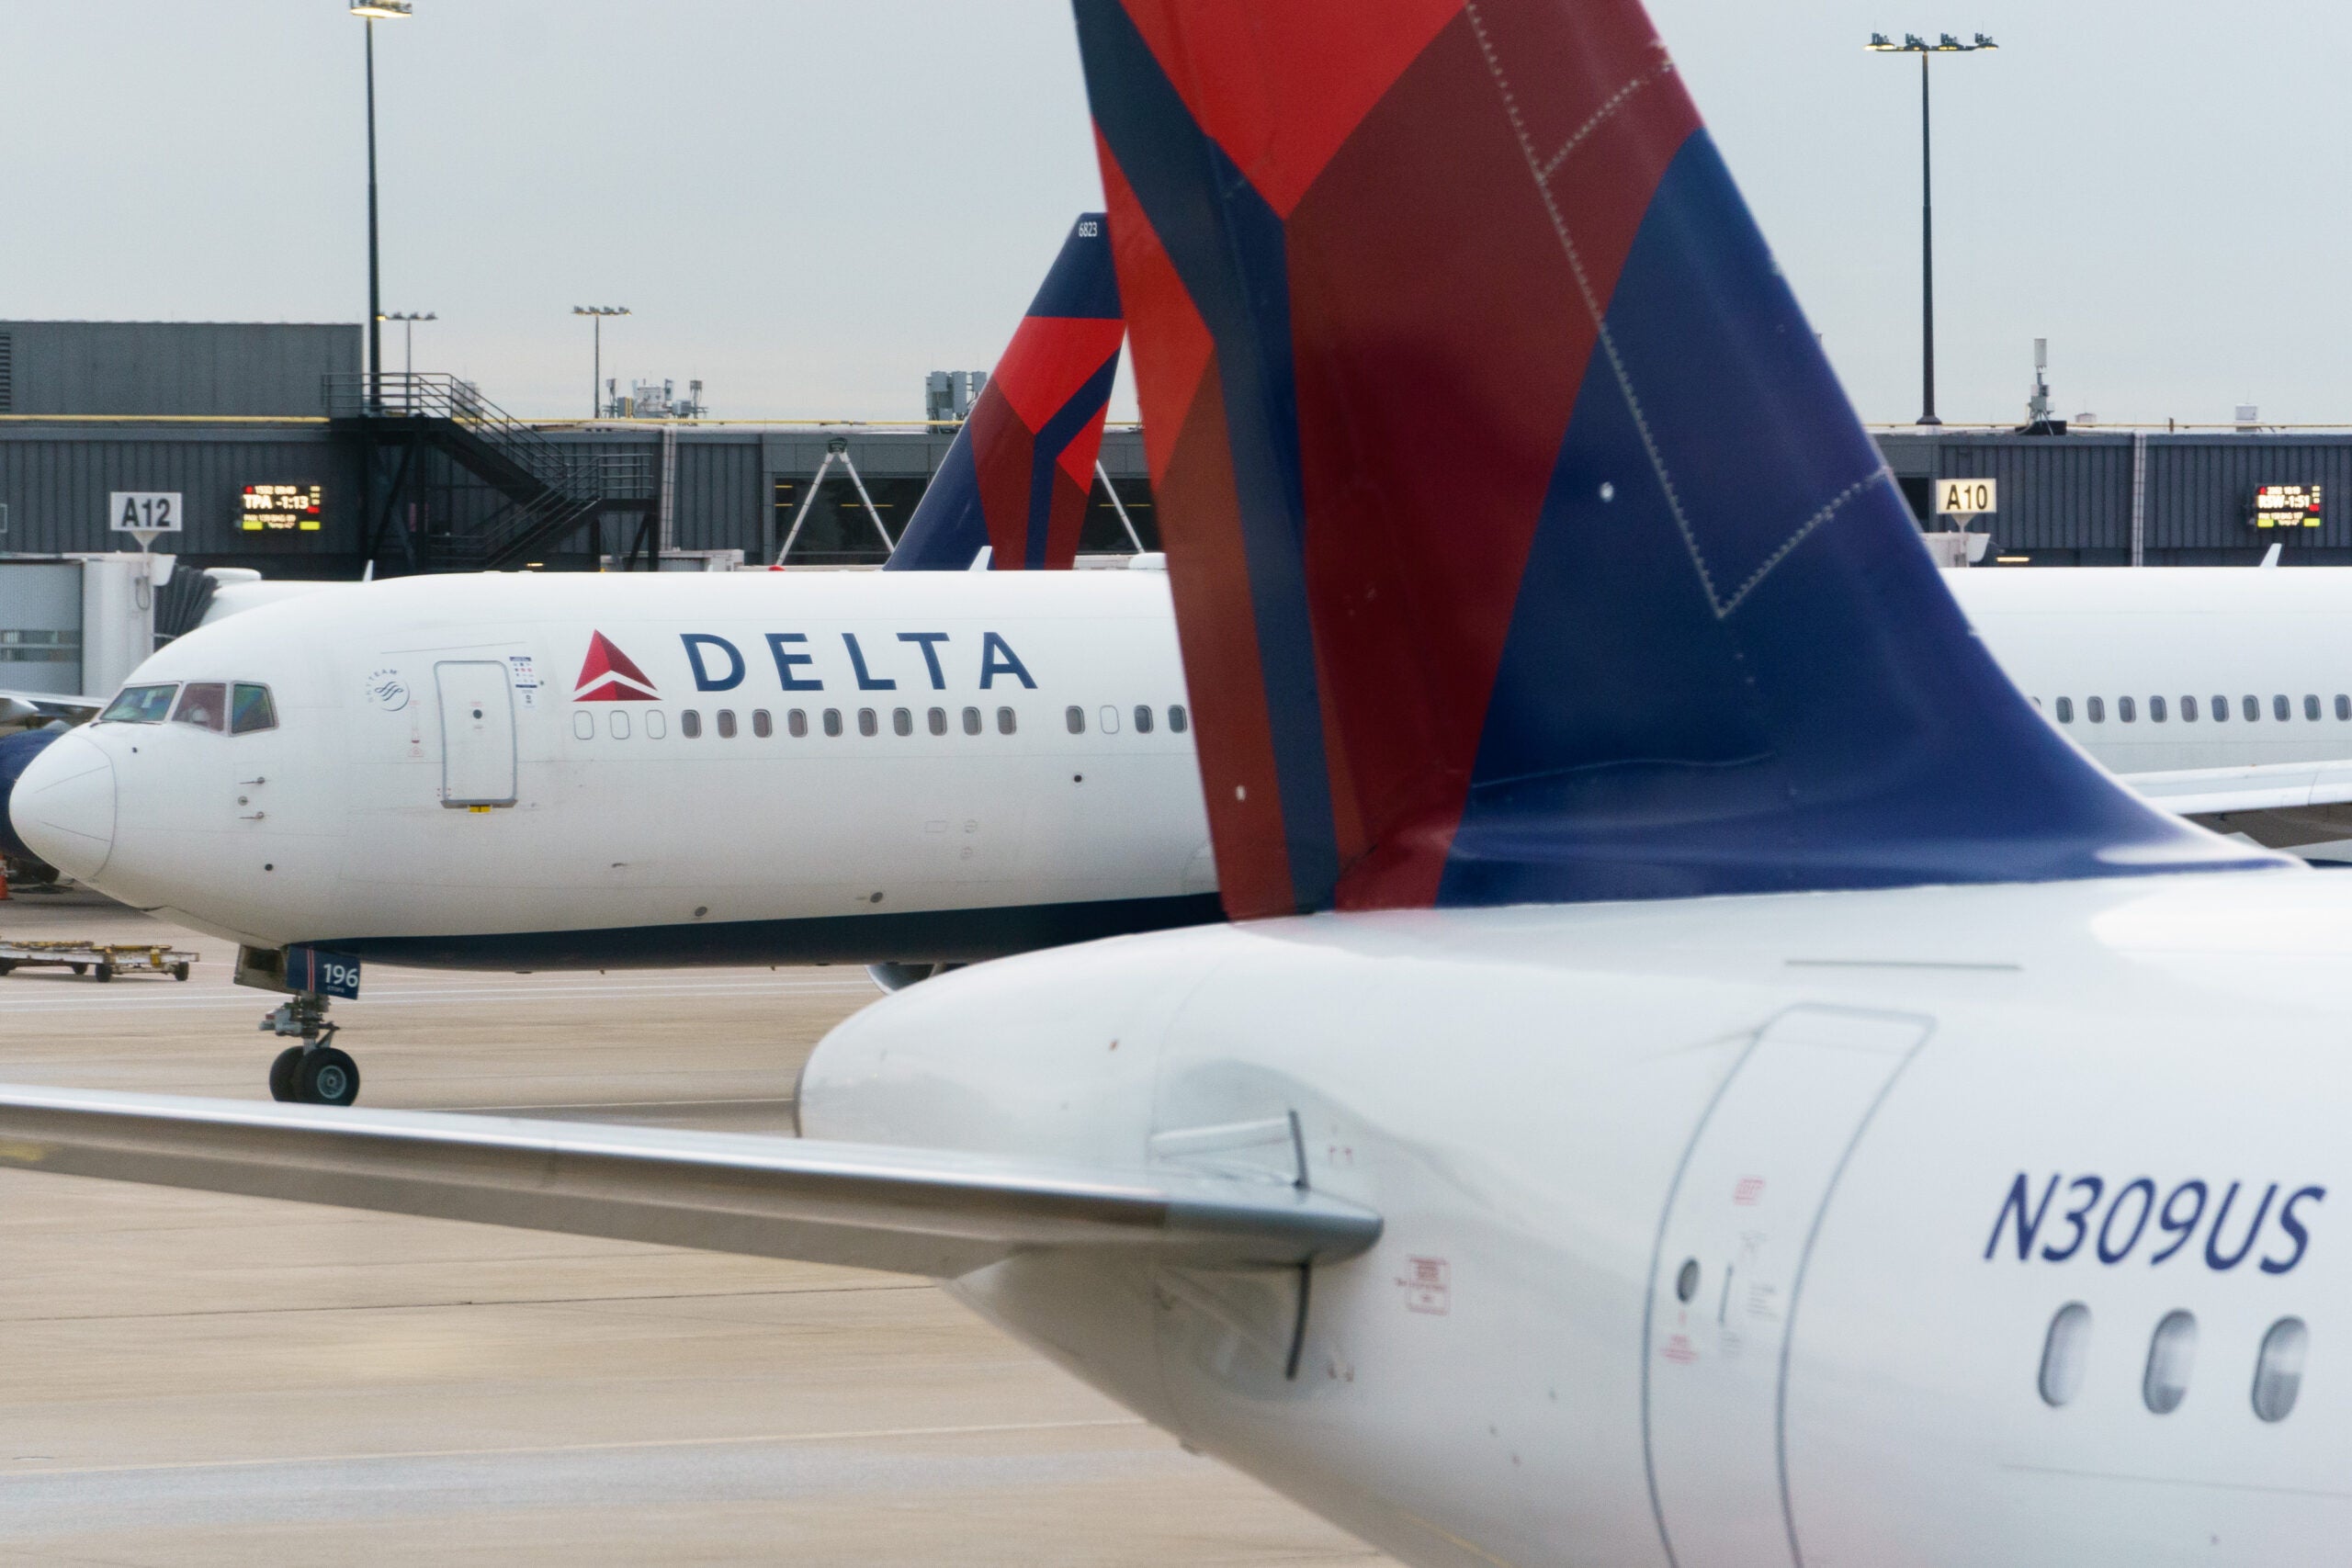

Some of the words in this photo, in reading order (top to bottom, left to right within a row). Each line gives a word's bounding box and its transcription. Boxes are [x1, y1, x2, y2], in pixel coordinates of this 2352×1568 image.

[1079, 221, 1098, 237] 6823
[243, 494, 273, 509] TPA
[276, 495, 309, 509] -1:13
[1946, 484, 1987, 510] A10
[121, 497, 171, 526] A12
[679, 632, 1038, 692] DELTA
[323, 963, 358, 987] 196
[1984, 1172, 2326, 1275] N309US
